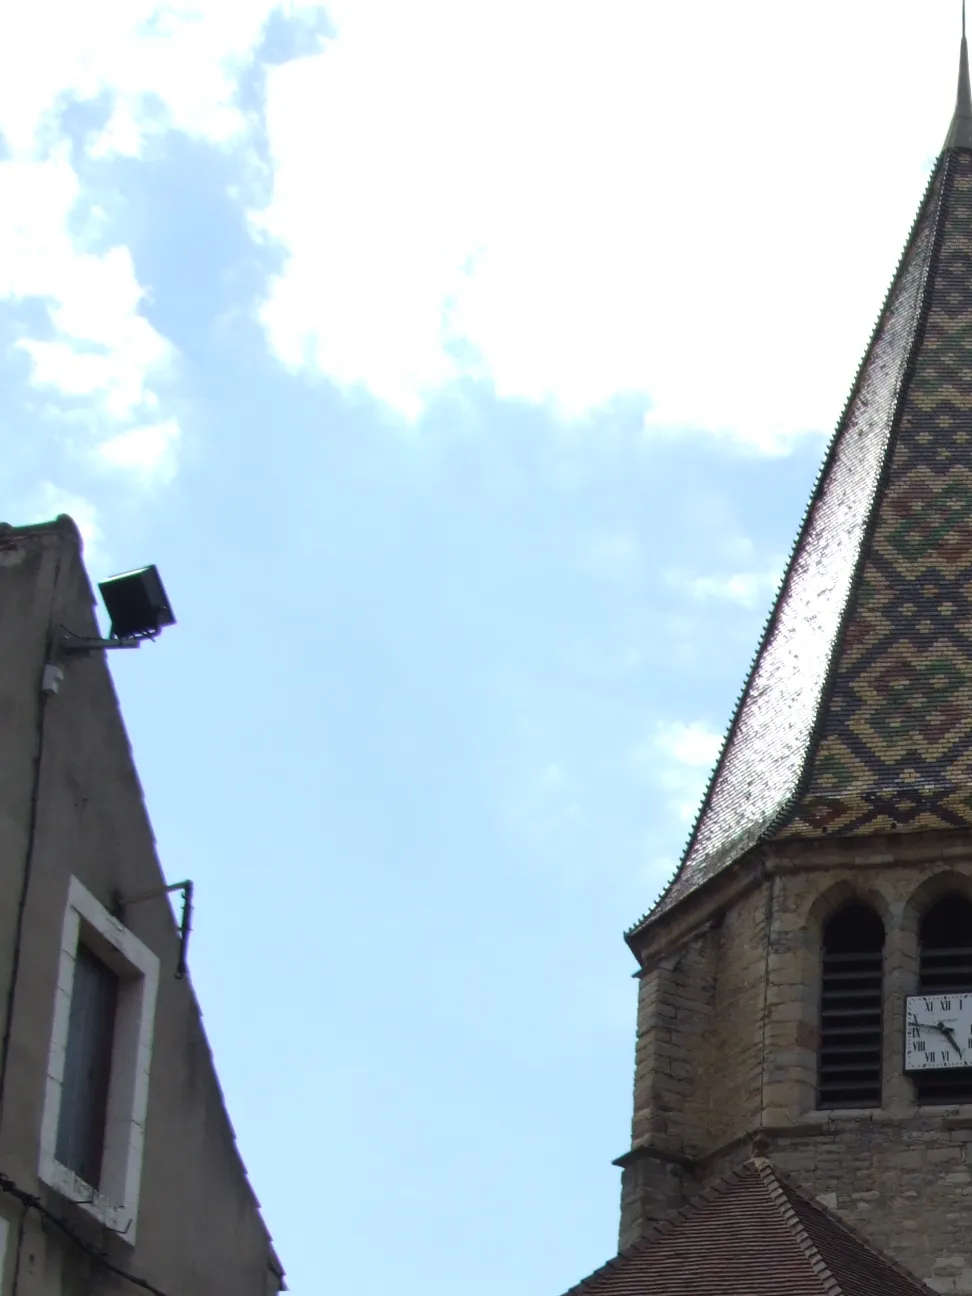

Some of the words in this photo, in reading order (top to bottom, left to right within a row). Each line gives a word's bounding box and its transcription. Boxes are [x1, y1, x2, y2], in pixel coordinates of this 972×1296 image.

[925, 1001, 933, 1012] XI
[940, 1000, 951, 1011] XII
[912, 1040, 925, 1052] VIII
[925, 1052, 935, 1062] VII
[941, 1051, 949, 1062] VI
